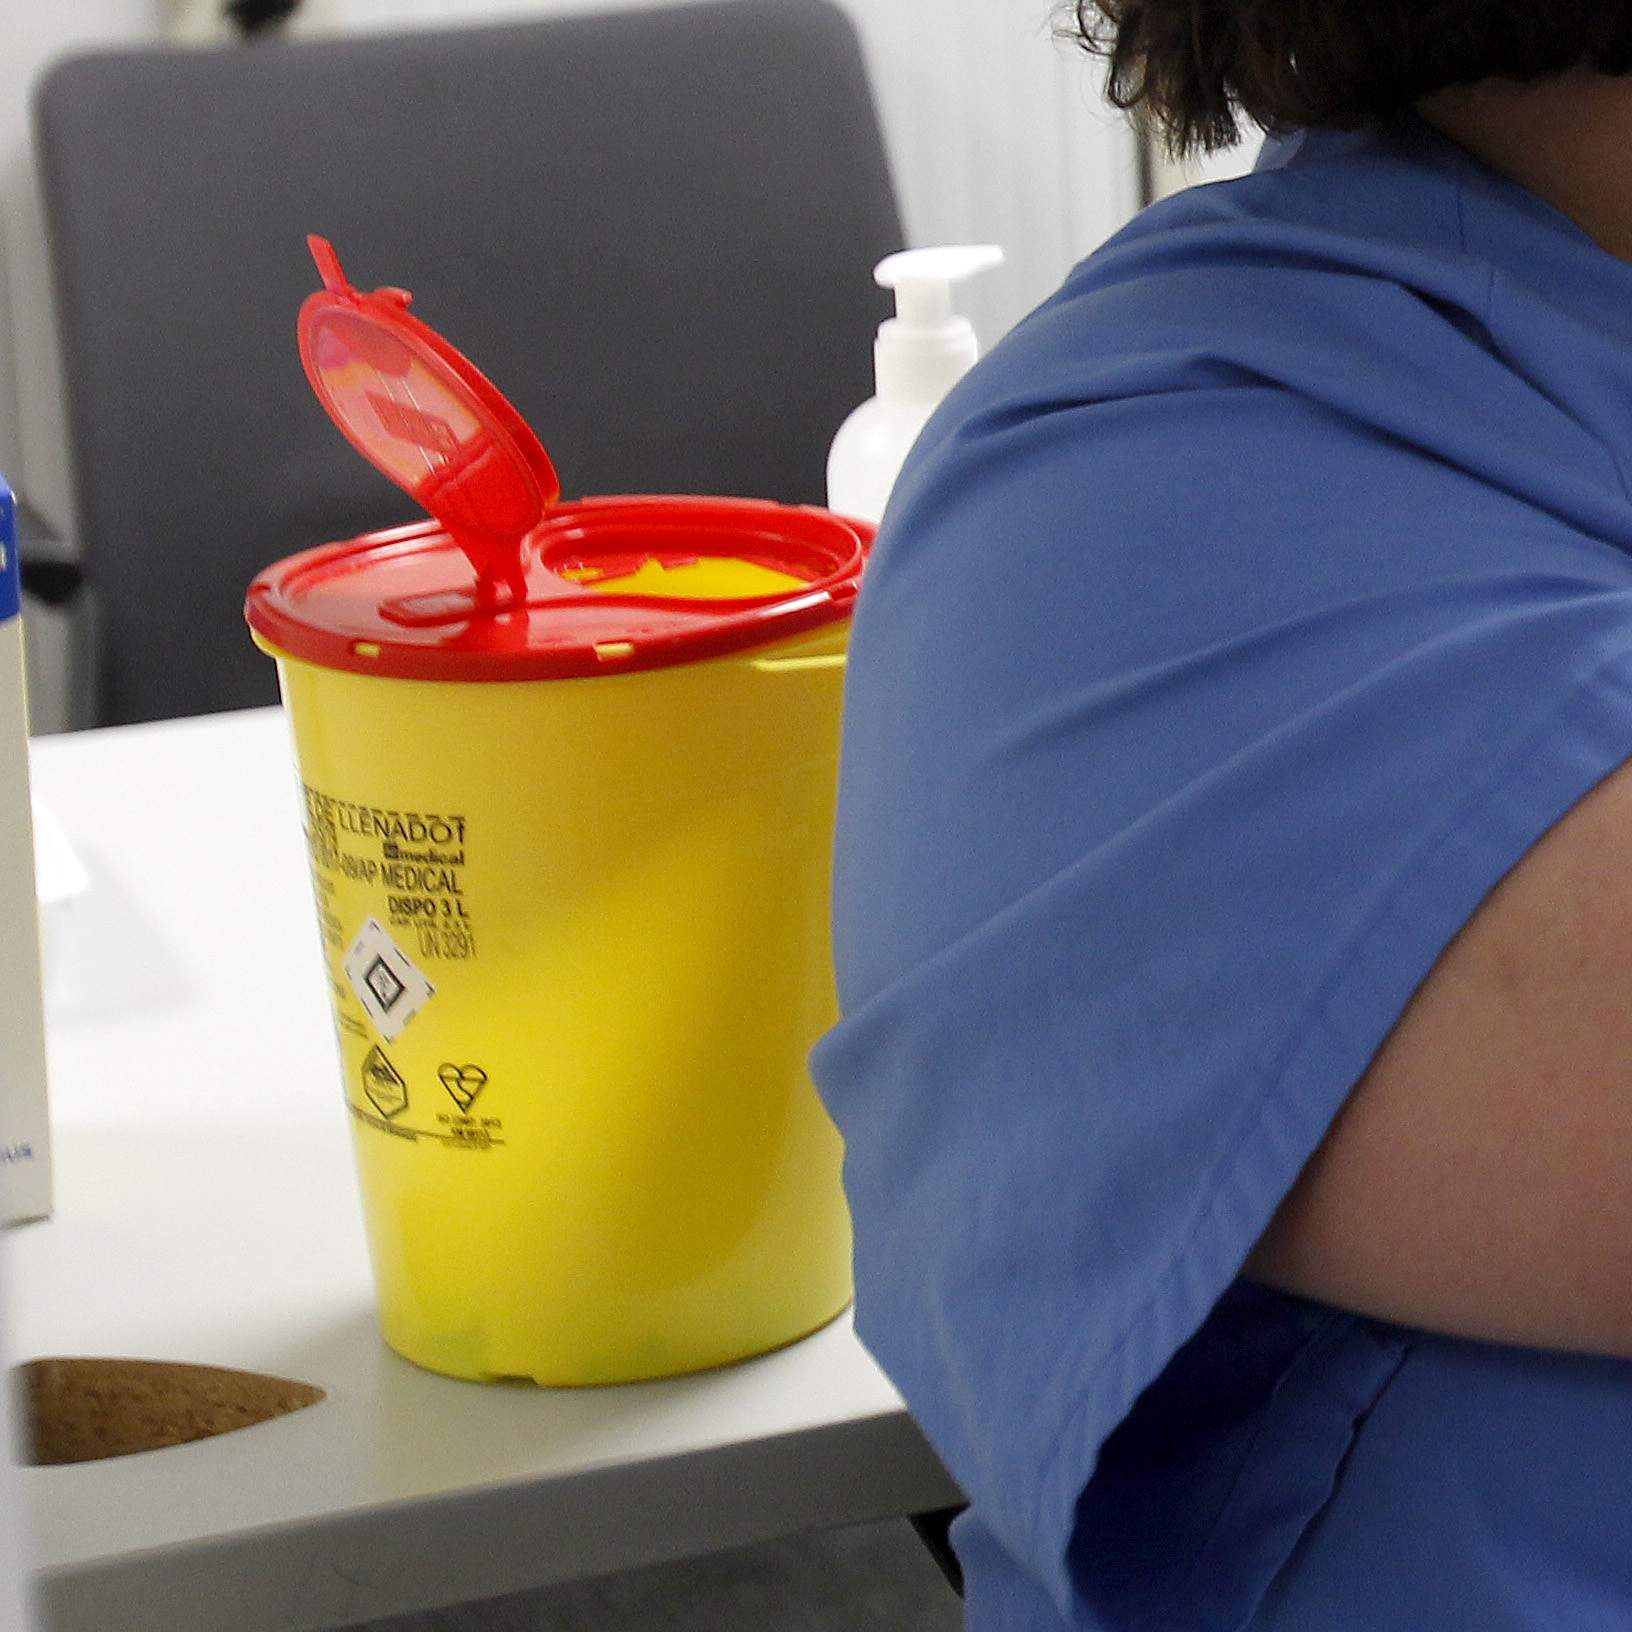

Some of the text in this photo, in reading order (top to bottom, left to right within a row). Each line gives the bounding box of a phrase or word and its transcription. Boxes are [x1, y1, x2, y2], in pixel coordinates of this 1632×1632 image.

[381, 862, 464, 895] MEDICAL
[388, 895, 469, 918] DISPO 3 L
